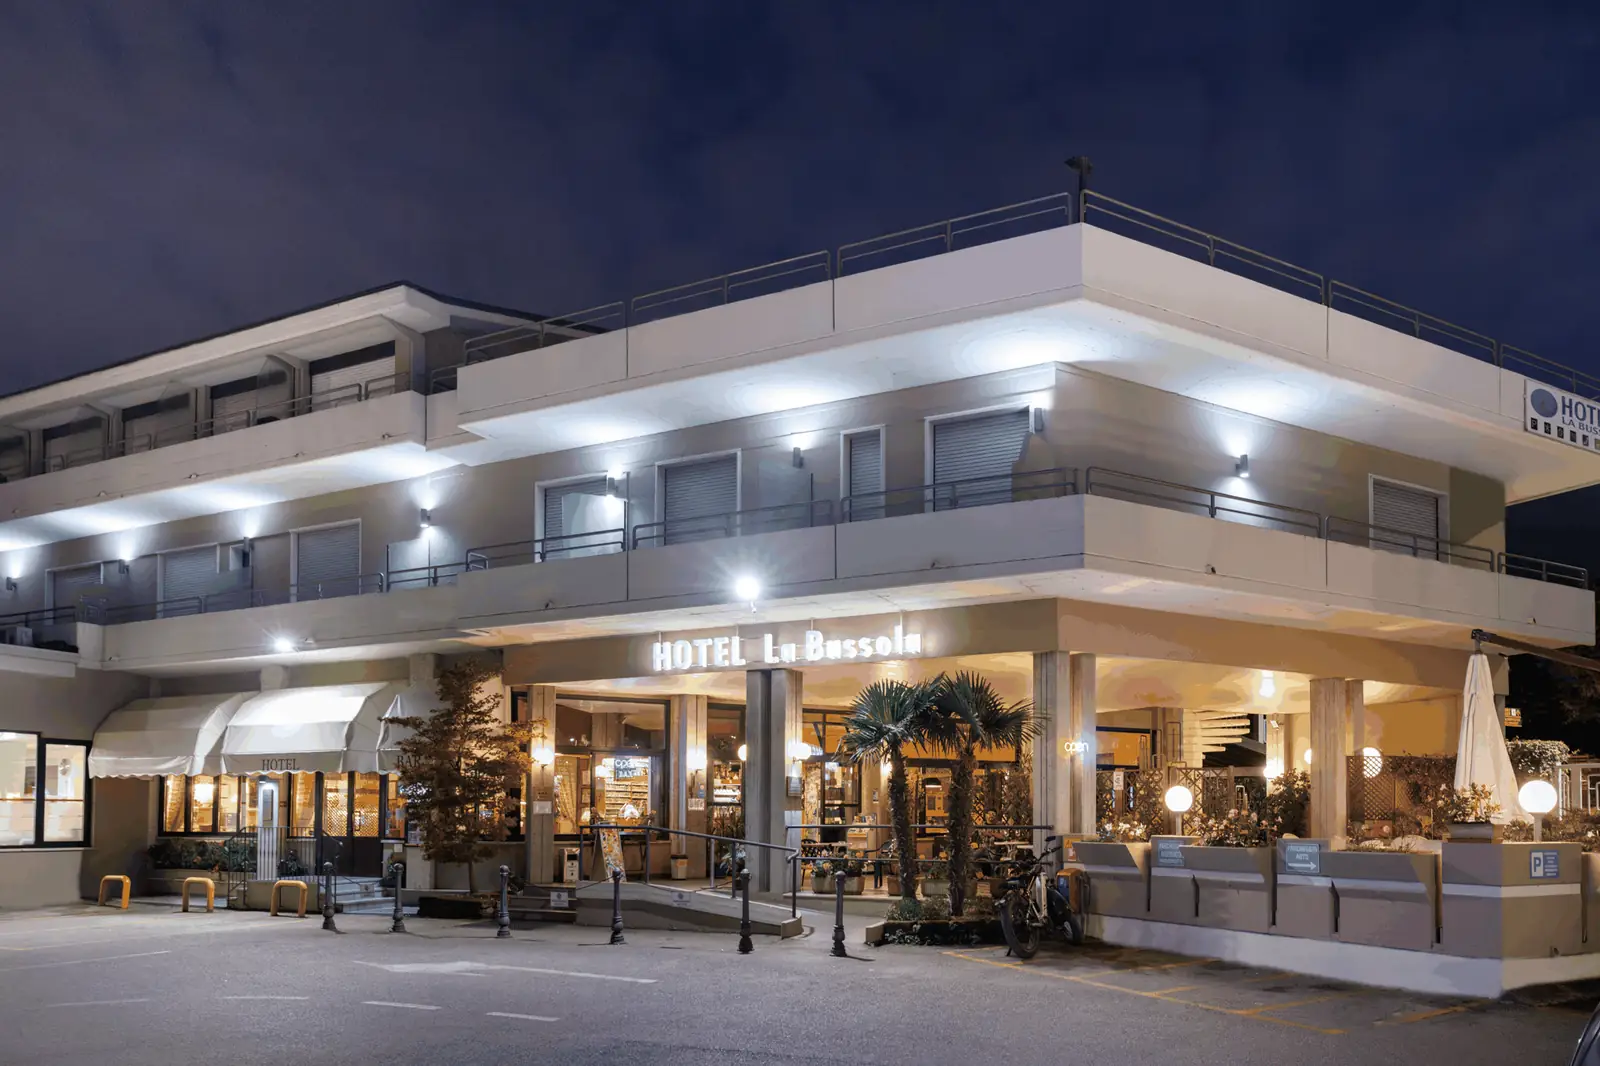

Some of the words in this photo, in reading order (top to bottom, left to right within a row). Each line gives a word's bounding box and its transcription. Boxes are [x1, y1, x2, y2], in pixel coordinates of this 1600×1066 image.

[1562, 416, 1576, 428] LA
[1578, 421, 1600, 436] BUS
[652, 636, 746, 671] HOTEL
[763, 633, 796, 664] La
[805, 625, 921, 661] Bussola
[1064, 741, 1089, 755] open
[261, 758, 299, 772] HOTEL
[1533, 856, 1542, 873] P
